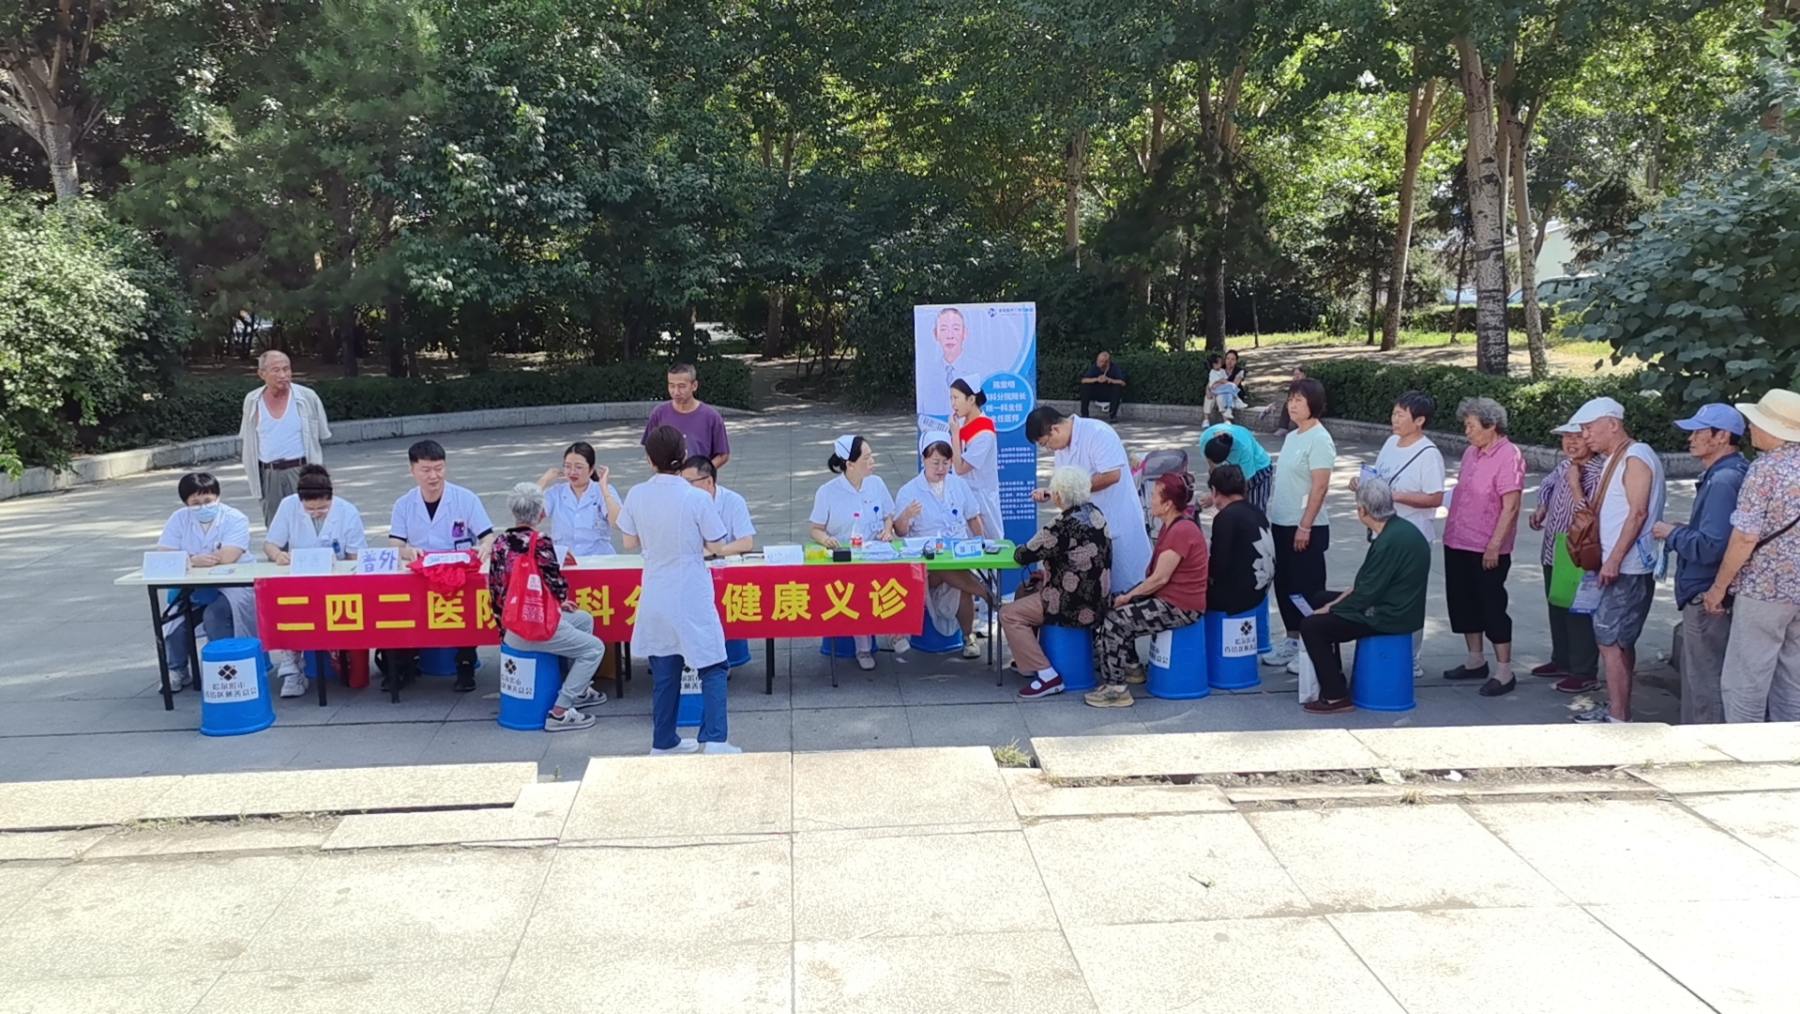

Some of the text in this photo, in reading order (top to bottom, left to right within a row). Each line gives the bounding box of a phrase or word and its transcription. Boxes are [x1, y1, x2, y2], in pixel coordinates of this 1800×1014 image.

[986, 392, 1027, 401] 科分院院长
[362, 549, 396, 573] 普外
[277, 578, 908, 631] 二四二医科健康义诊
